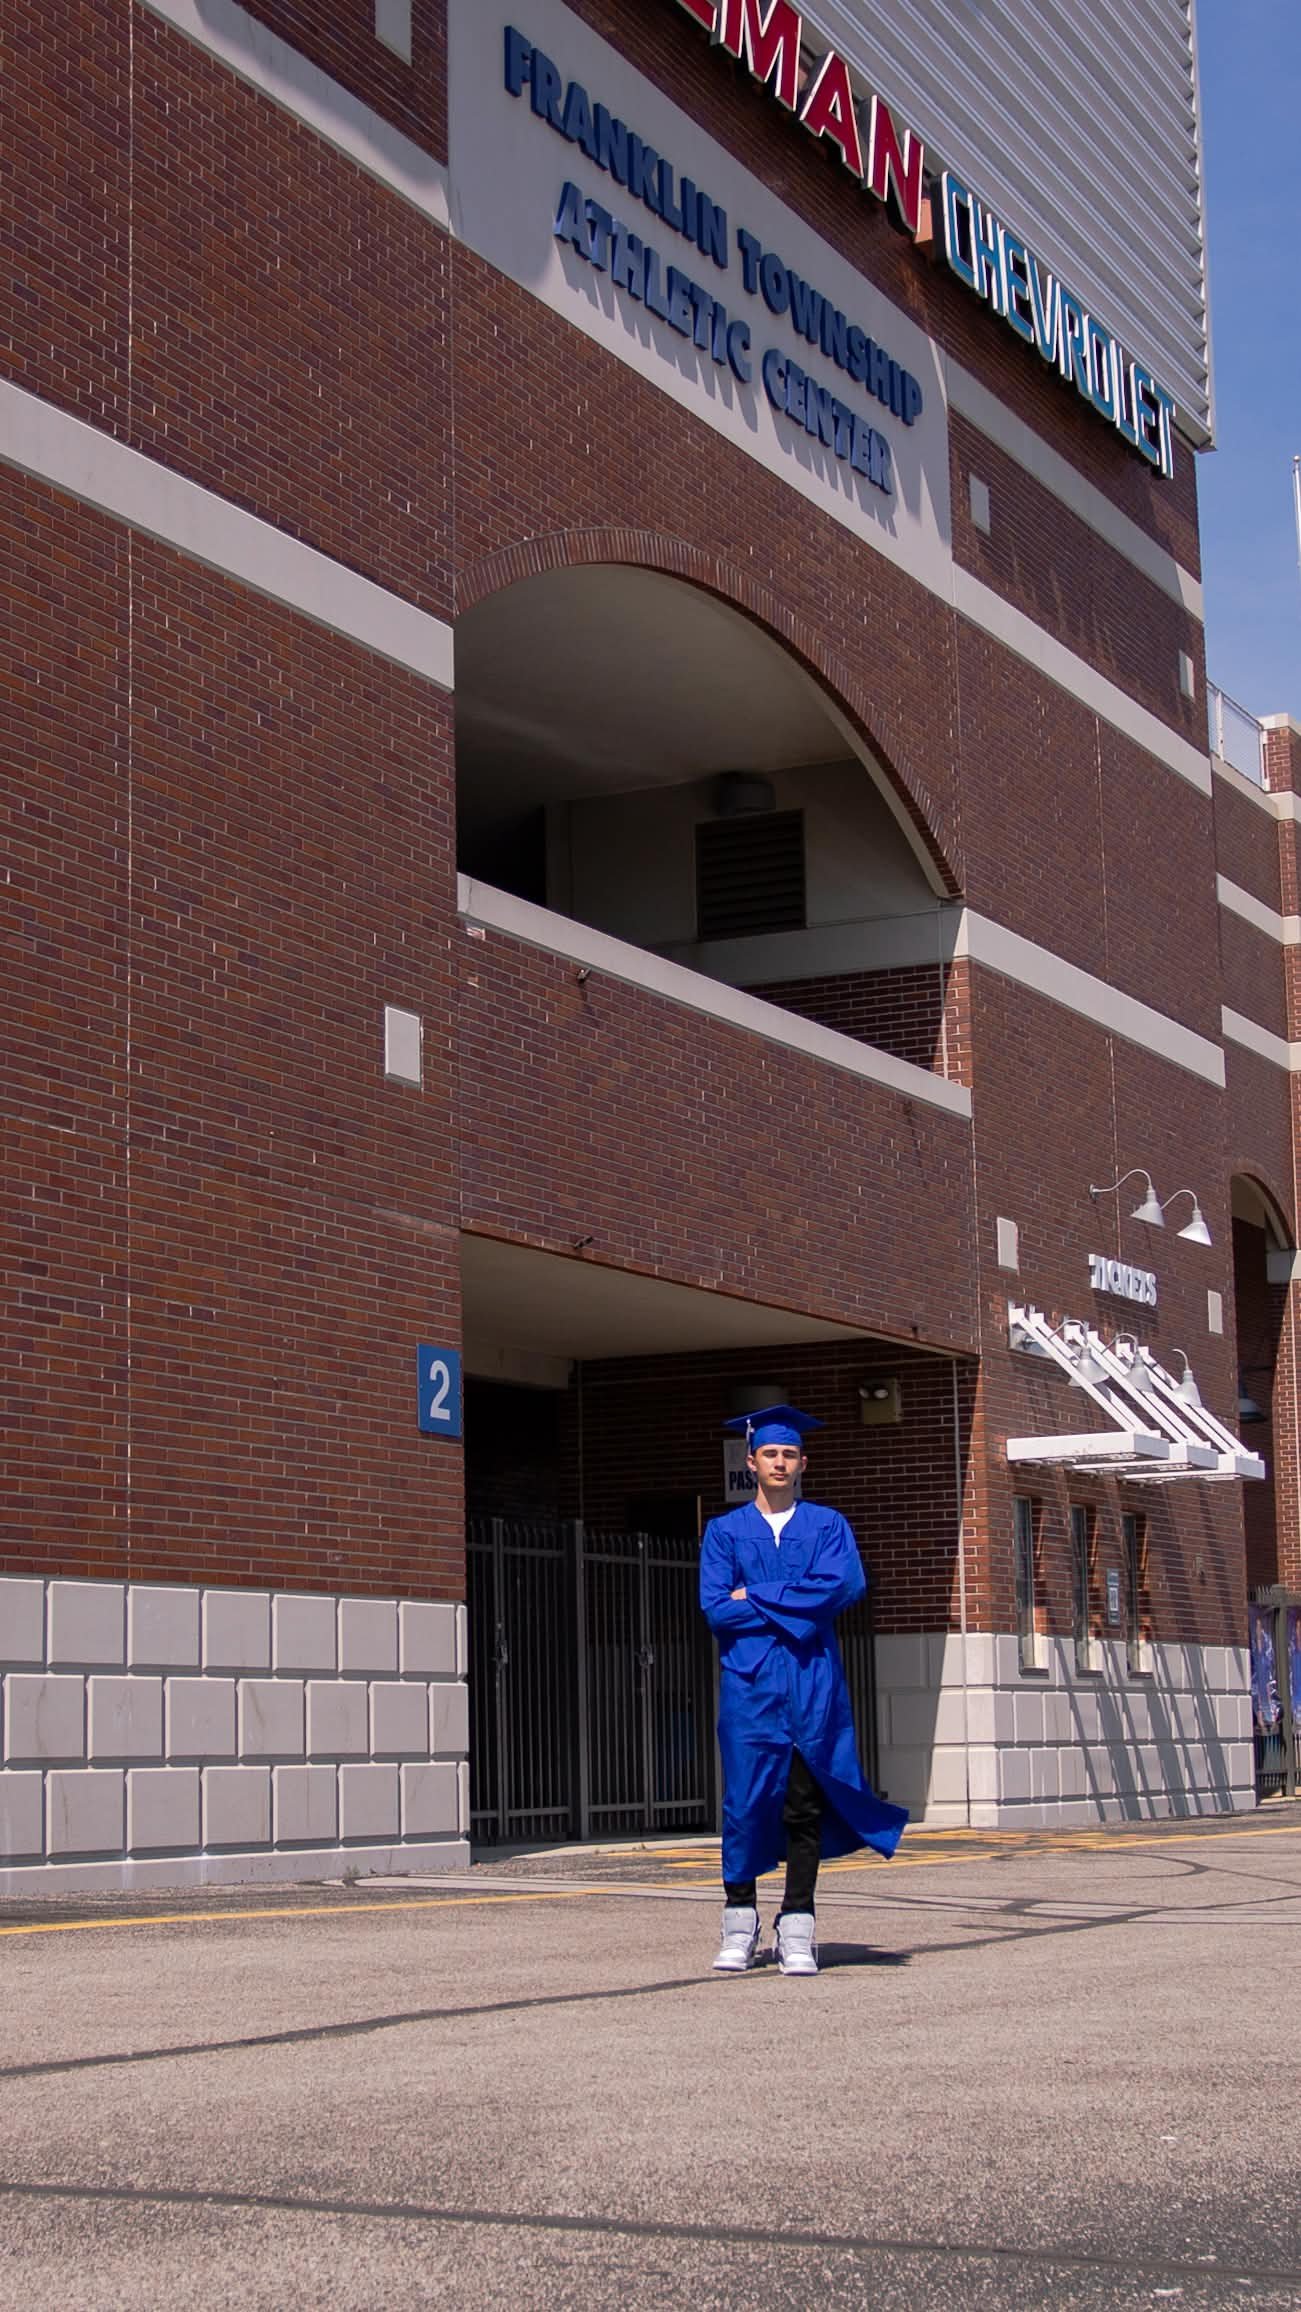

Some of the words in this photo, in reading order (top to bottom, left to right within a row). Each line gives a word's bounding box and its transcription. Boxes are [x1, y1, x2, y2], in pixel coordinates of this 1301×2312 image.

[504, 26, 728, 268] FRANKLIN
[737, 227, 922, 427] TOWNSHIP
[676, 0, 924, 234] MAN
[938, 171, 1175, 480] CHEVROLET
[553, 182, 751, 383] ATHLETIC
[762, 348, 892, 494] CENTER
[1089, 1254, 1157, 1306] TICKETS
[430, 1360, 450, 1420] 2
[729, 1471, 758, 1491] PAS
